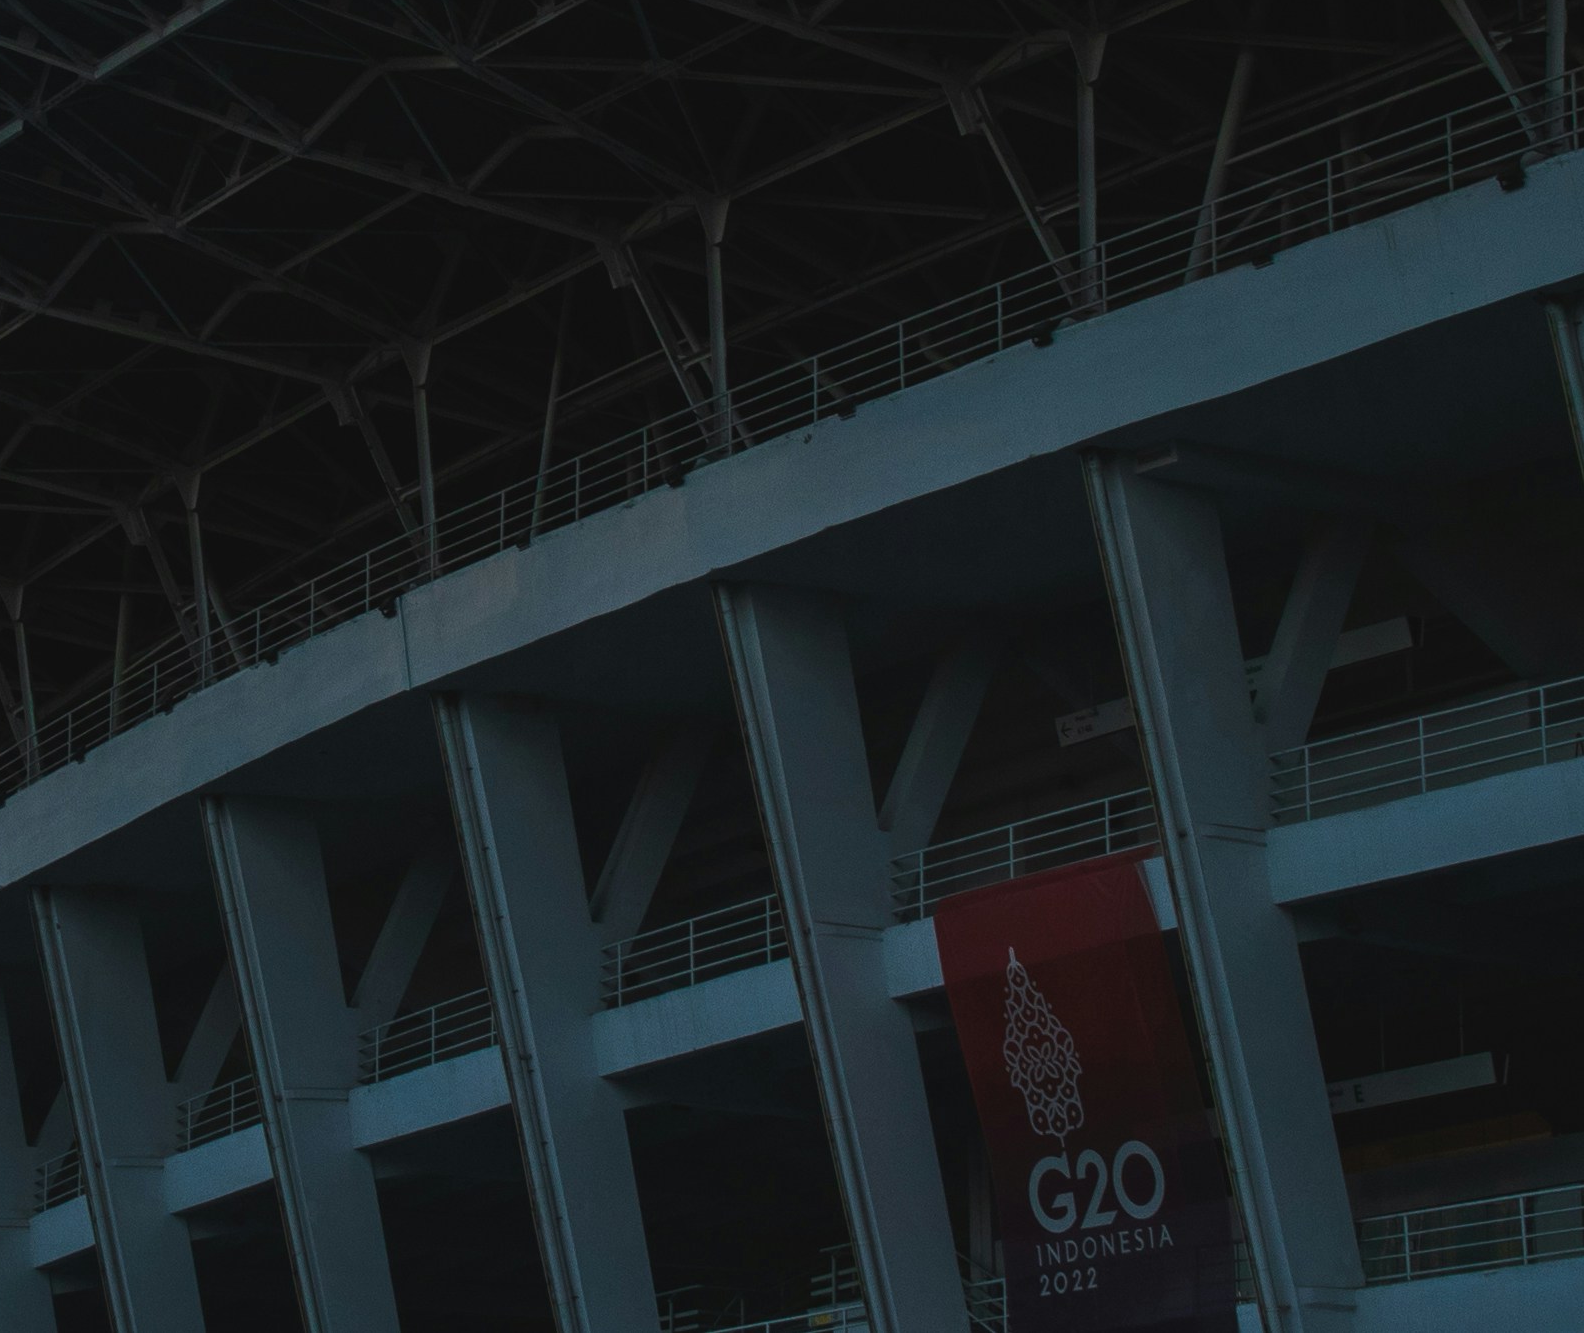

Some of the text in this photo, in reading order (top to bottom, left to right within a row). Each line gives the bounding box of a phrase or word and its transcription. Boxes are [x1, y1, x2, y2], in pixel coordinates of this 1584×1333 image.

[1353, 1083, 1365, 1104] E
[1029, 1140, 1165, 1233] G20
[1037, 1225, 1174, 1267] INDONESIA
[1040, 1268, 1098, 1296] 2022
